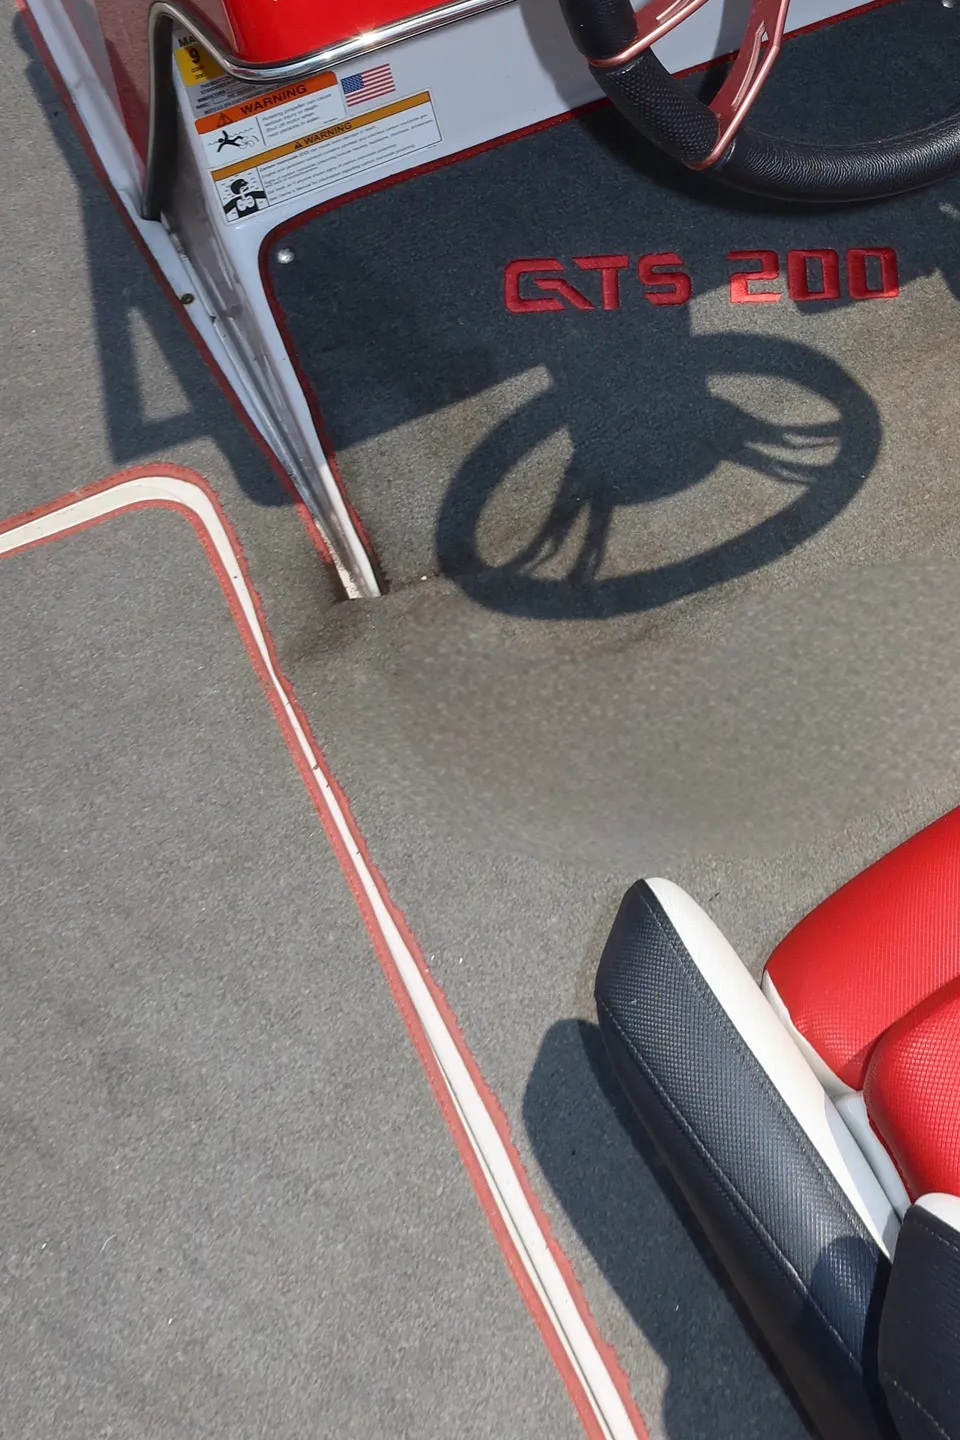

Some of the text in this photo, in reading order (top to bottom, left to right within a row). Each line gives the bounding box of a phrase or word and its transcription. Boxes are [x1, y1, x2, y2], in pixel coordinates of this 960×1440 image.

[188, 47, 201, 64] 9
[240, 84, 307, 115] WARNING
[304, 122, 352, 145] WARNING
[503, 246, 900, 314] GTS 200
